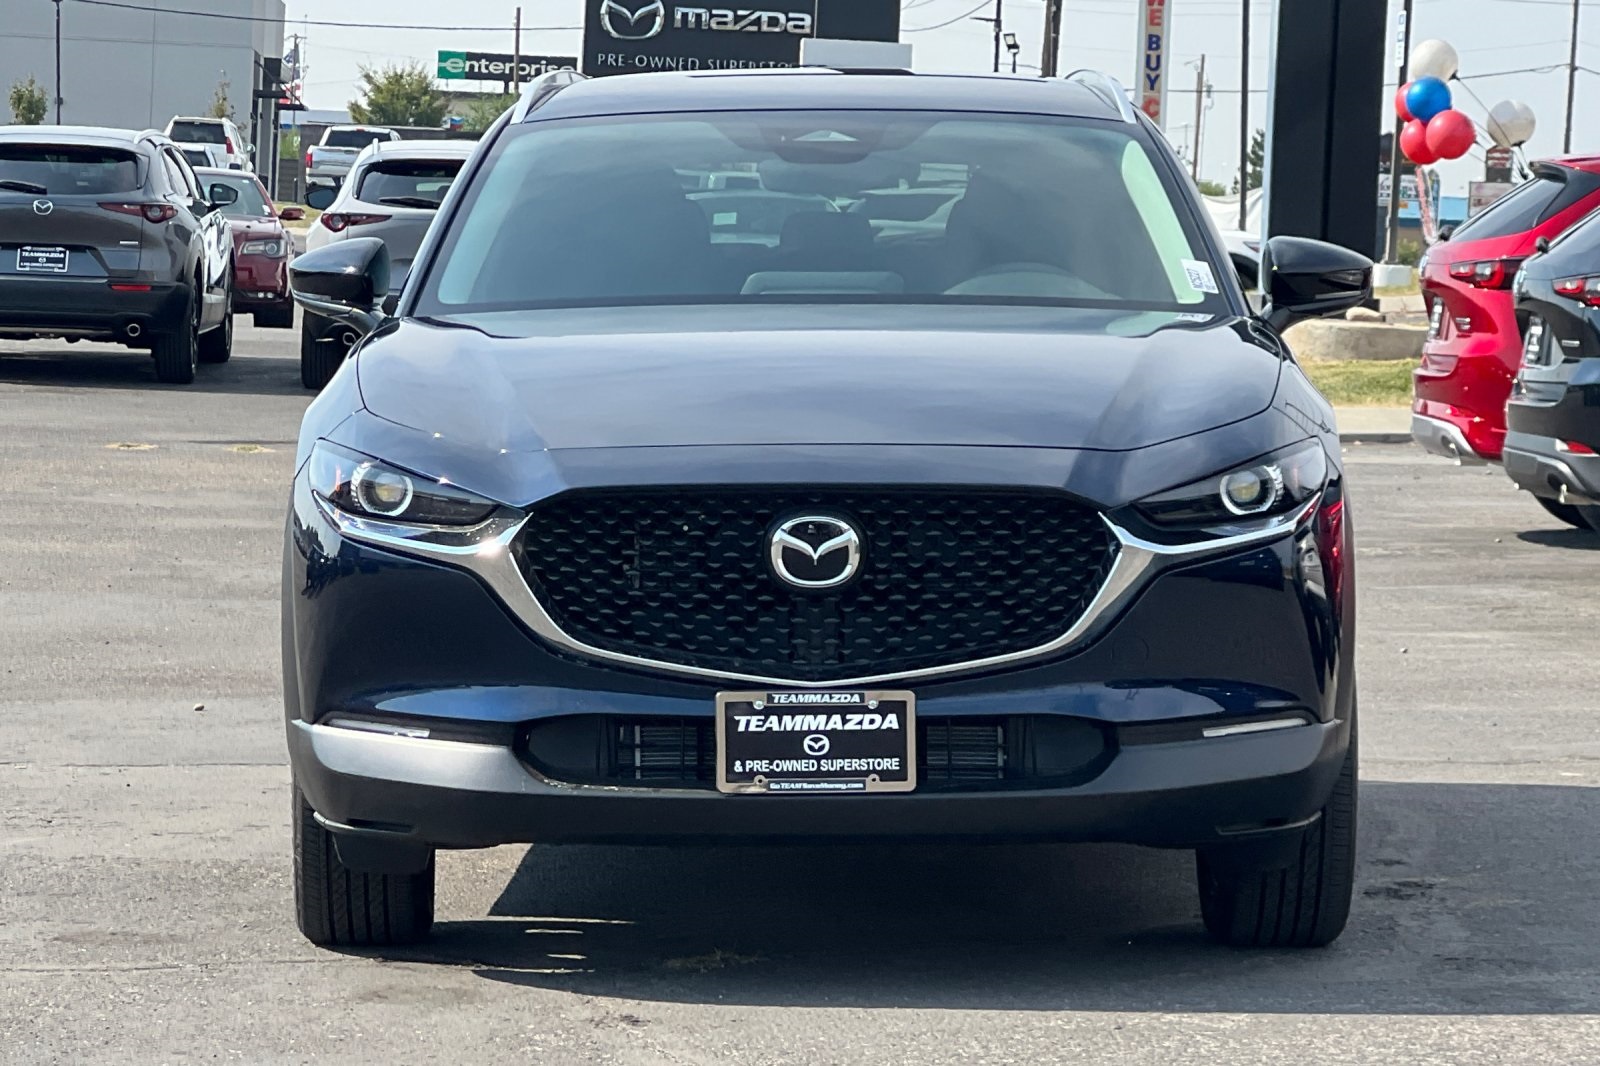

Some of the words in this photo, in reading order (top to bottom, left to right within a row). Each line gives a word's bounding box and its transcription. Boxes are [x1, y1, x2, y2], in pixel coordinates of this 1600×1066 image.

[597, 53, 699, 71] PRE-OWNED
[1145, 34, 1161, 91] BUY
[772, 693, 860, 704] TEAMMAZDA
[733, 713, 900, 732] TEAMMAZDA
[733, 761, 743, 772] &
[745, 760, 818, 772] PRE-OWNED
[820, 758, 900, 771] SUPERSTORE
